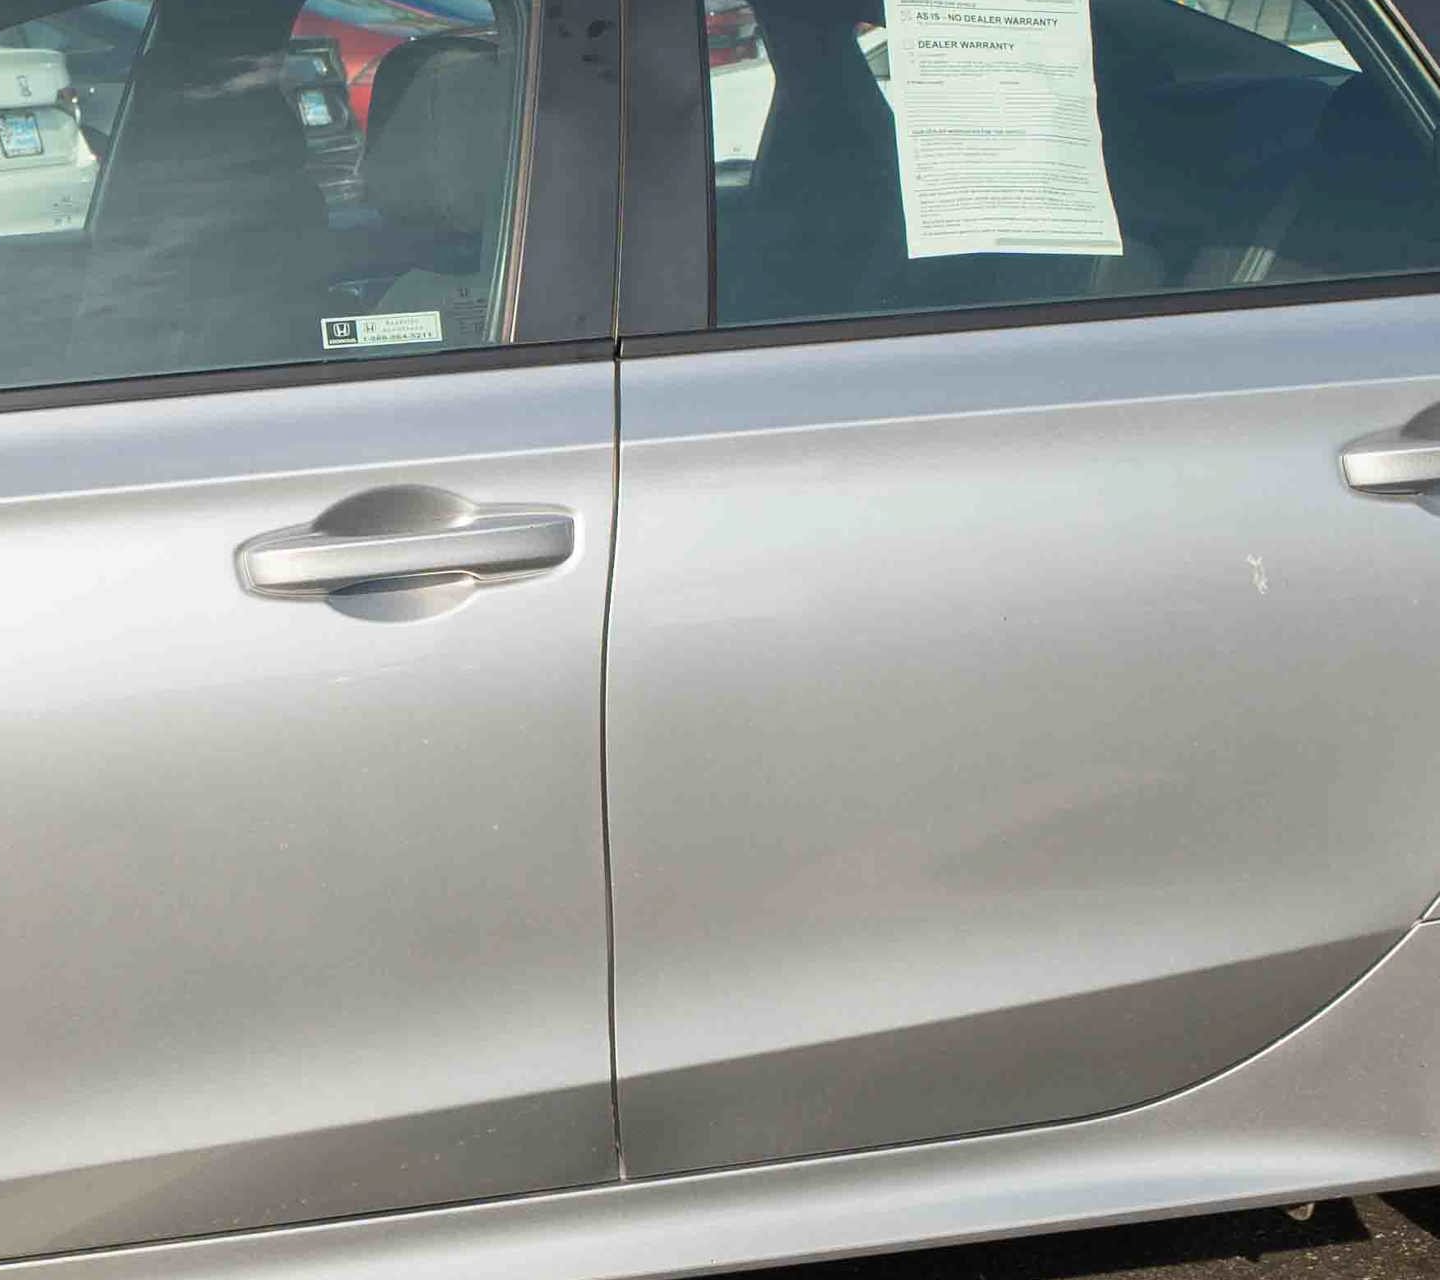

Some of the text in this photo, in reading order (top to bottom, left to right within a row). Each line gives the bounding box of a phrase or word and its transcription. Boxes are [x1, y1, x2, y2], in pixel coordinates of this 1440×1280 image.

[916, 12, 1058, 27] AS IS NO DEALER WARRANTY
[918, 40, 1015, 51] DEALER WARRANTY
